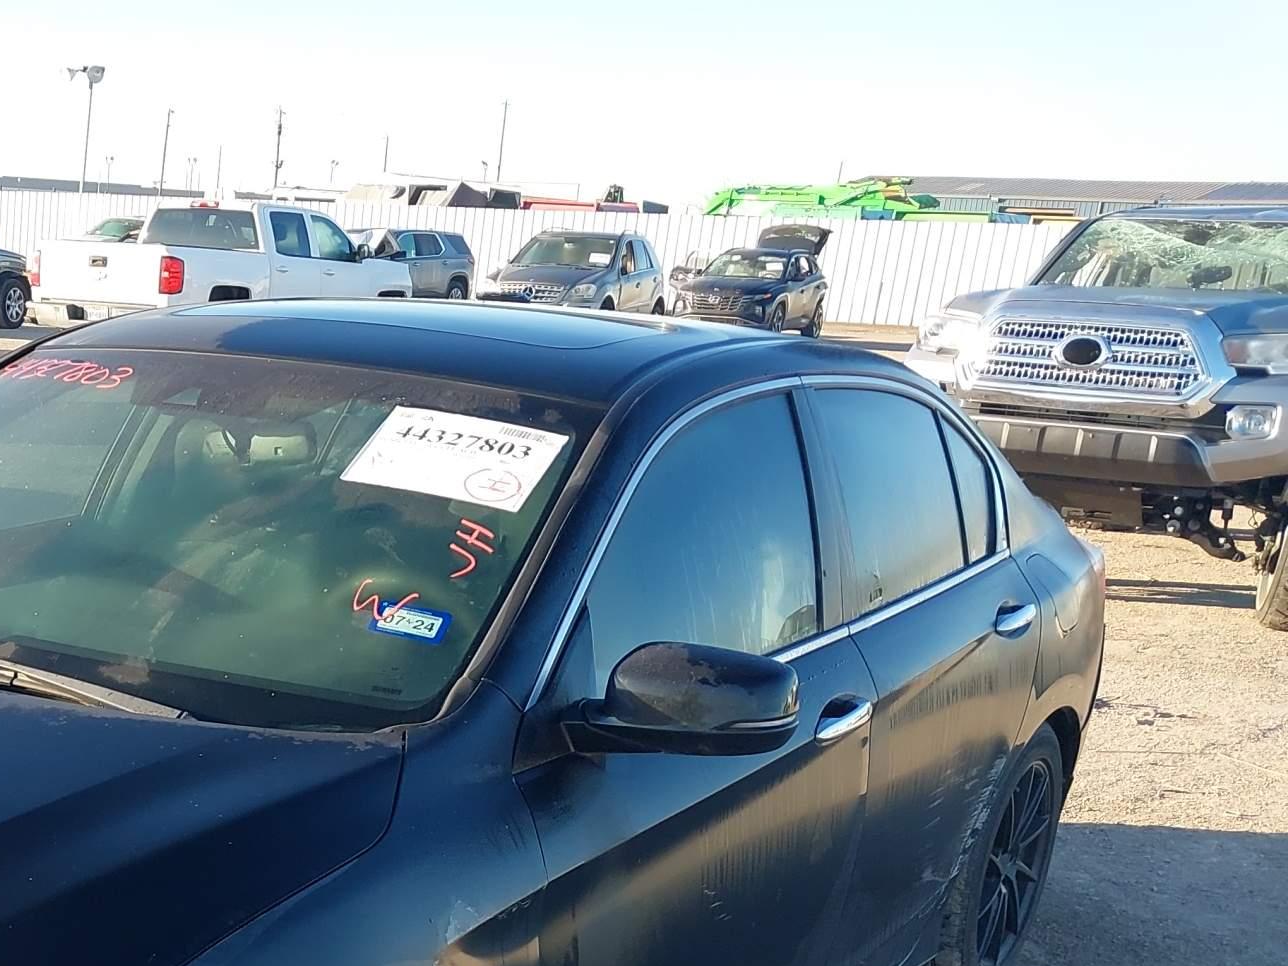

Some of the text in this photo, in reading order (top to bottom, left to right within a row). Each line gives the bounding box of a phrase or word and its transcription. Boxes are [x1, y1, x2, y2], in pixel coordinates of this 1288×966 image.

[396, 425, 533, 460] 44327803
[383, 614, 436, 633] 07 24
